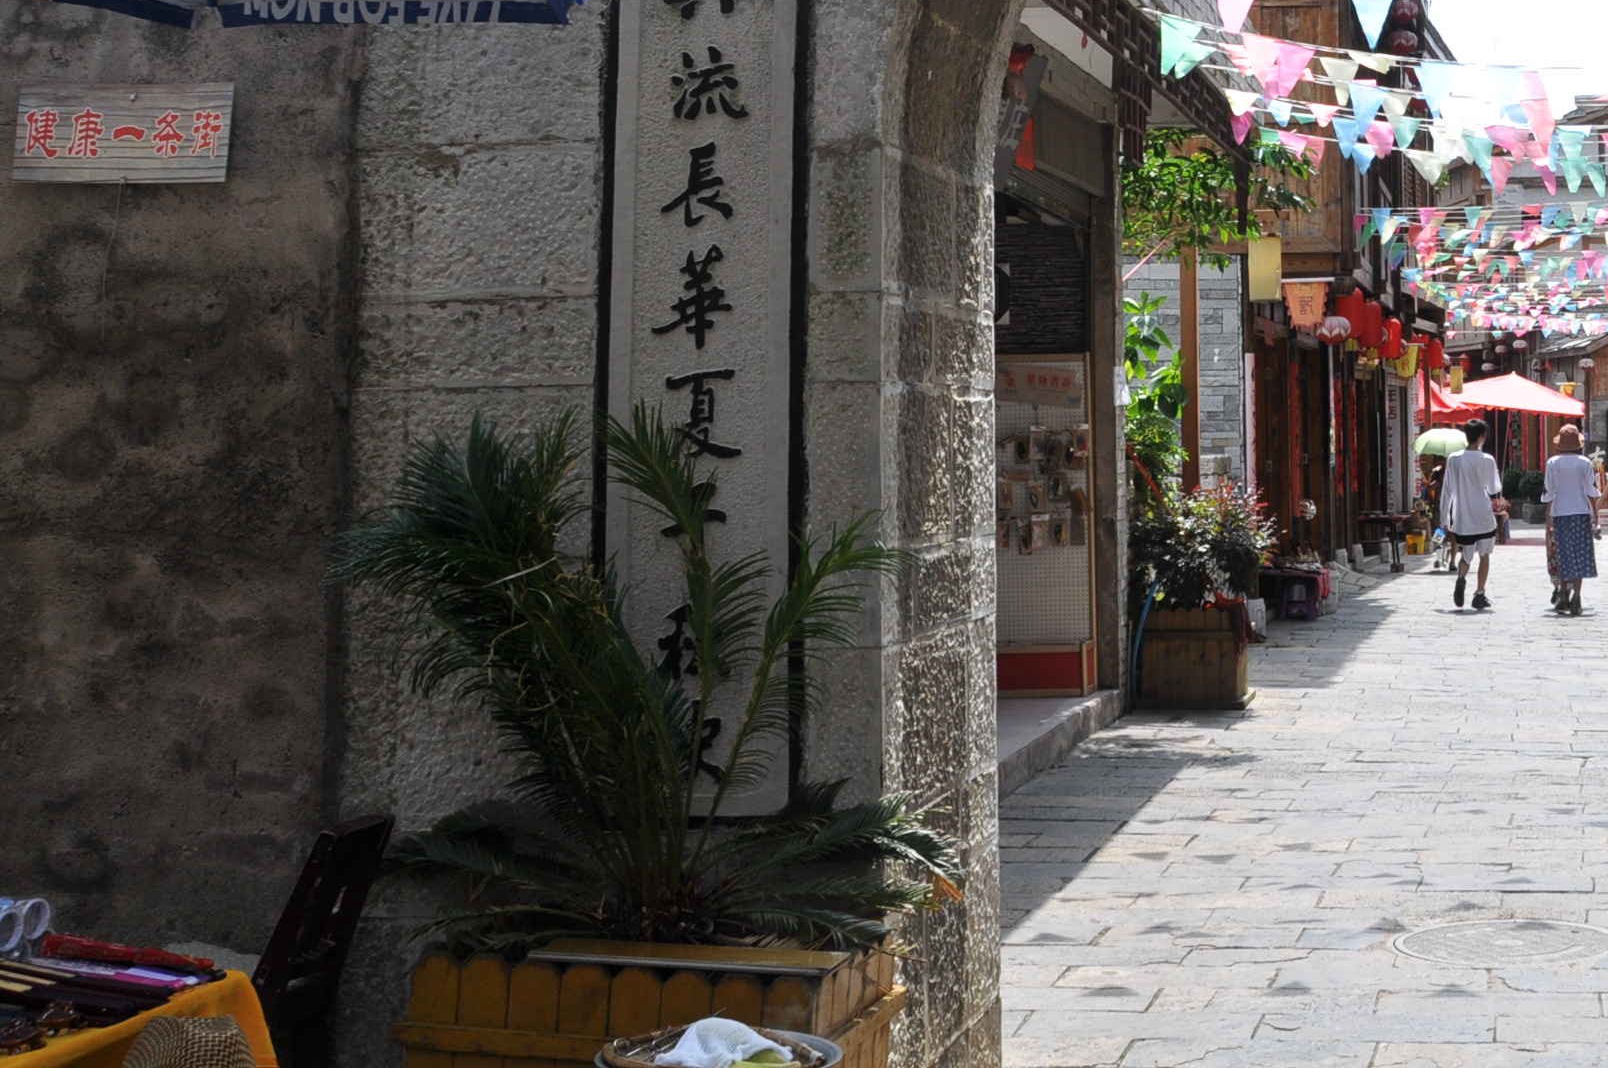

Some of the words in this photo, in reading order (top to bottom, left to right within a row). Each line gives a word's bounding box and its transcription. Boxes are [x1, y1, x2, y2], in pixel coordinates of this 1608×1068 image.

[23, 107, 223, 159] 健康一条街
